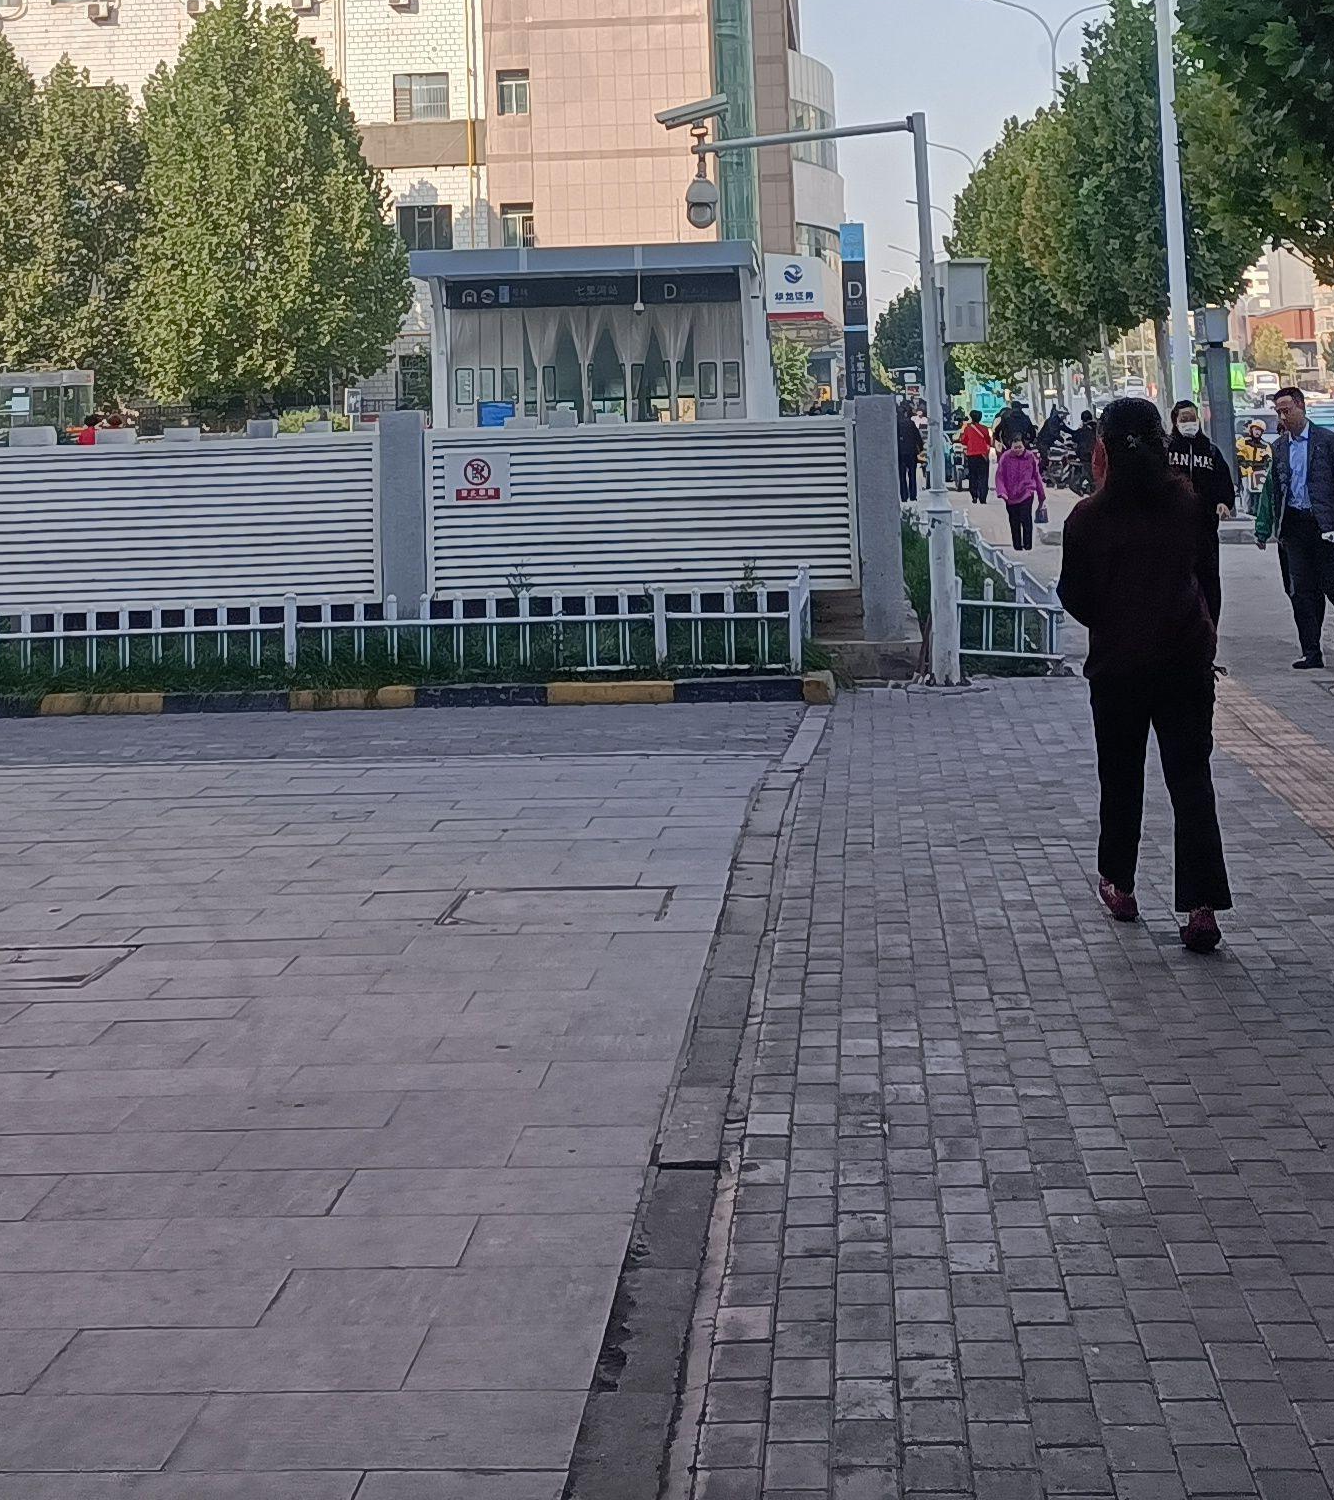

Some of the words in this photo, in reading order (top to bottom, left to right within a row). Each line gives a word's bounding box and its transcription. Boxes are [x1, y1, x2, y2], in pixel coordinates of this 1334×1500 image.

[574, 284, 619, 297] 七里河站
[663, 283, 677, 299] D
[847, 281, 864, 299] D
[856, 351, 867, 393] 七里河站
